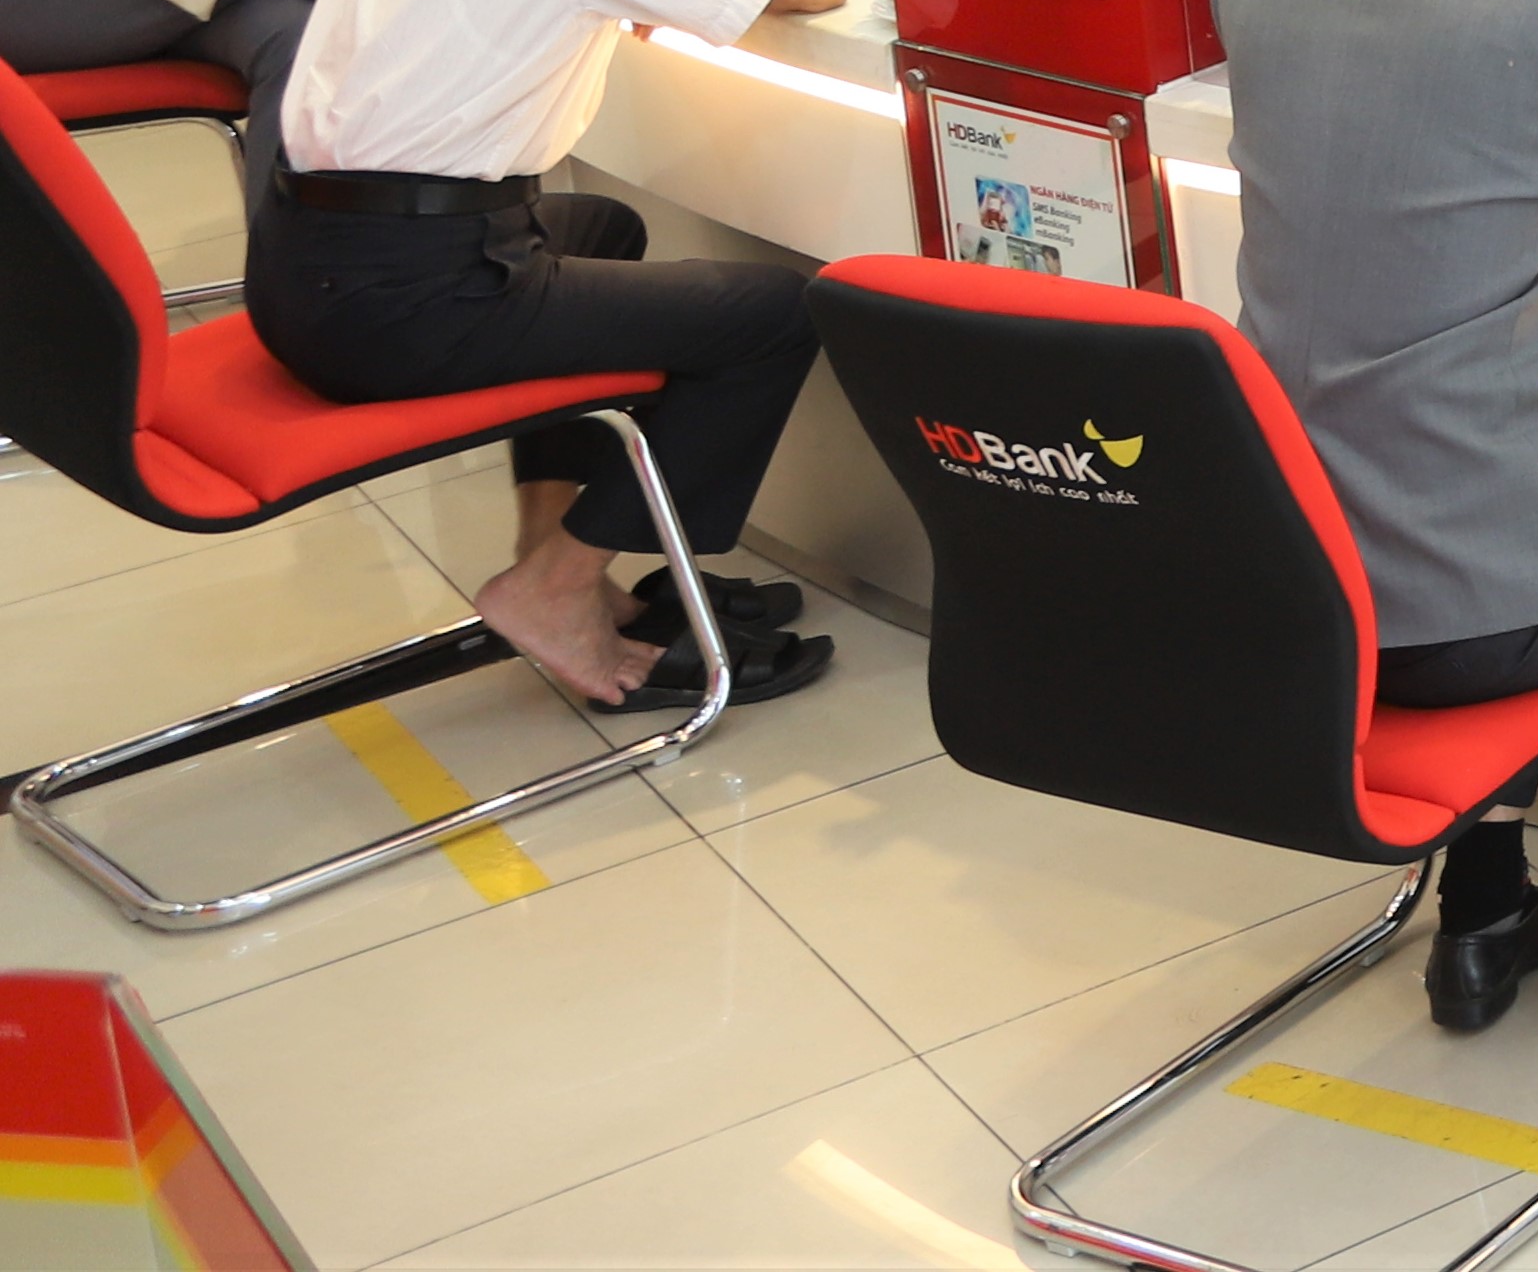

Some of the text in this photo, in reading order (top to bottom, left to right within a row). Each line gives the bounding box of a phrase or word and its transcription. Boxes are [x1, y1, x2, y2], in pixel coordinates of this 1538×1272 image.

[947, 121, 1003, 150] HDBank
[1034, 215, 1070, 234] eBanking
[1051, 206, 1082, 224] Banking
[915, 416, 1107, 484] HDBank
[939, 458, 971, 477] Cam
[1059, 486, 1090, 501] cao
[1096, 489, 1139, 506] nhất
